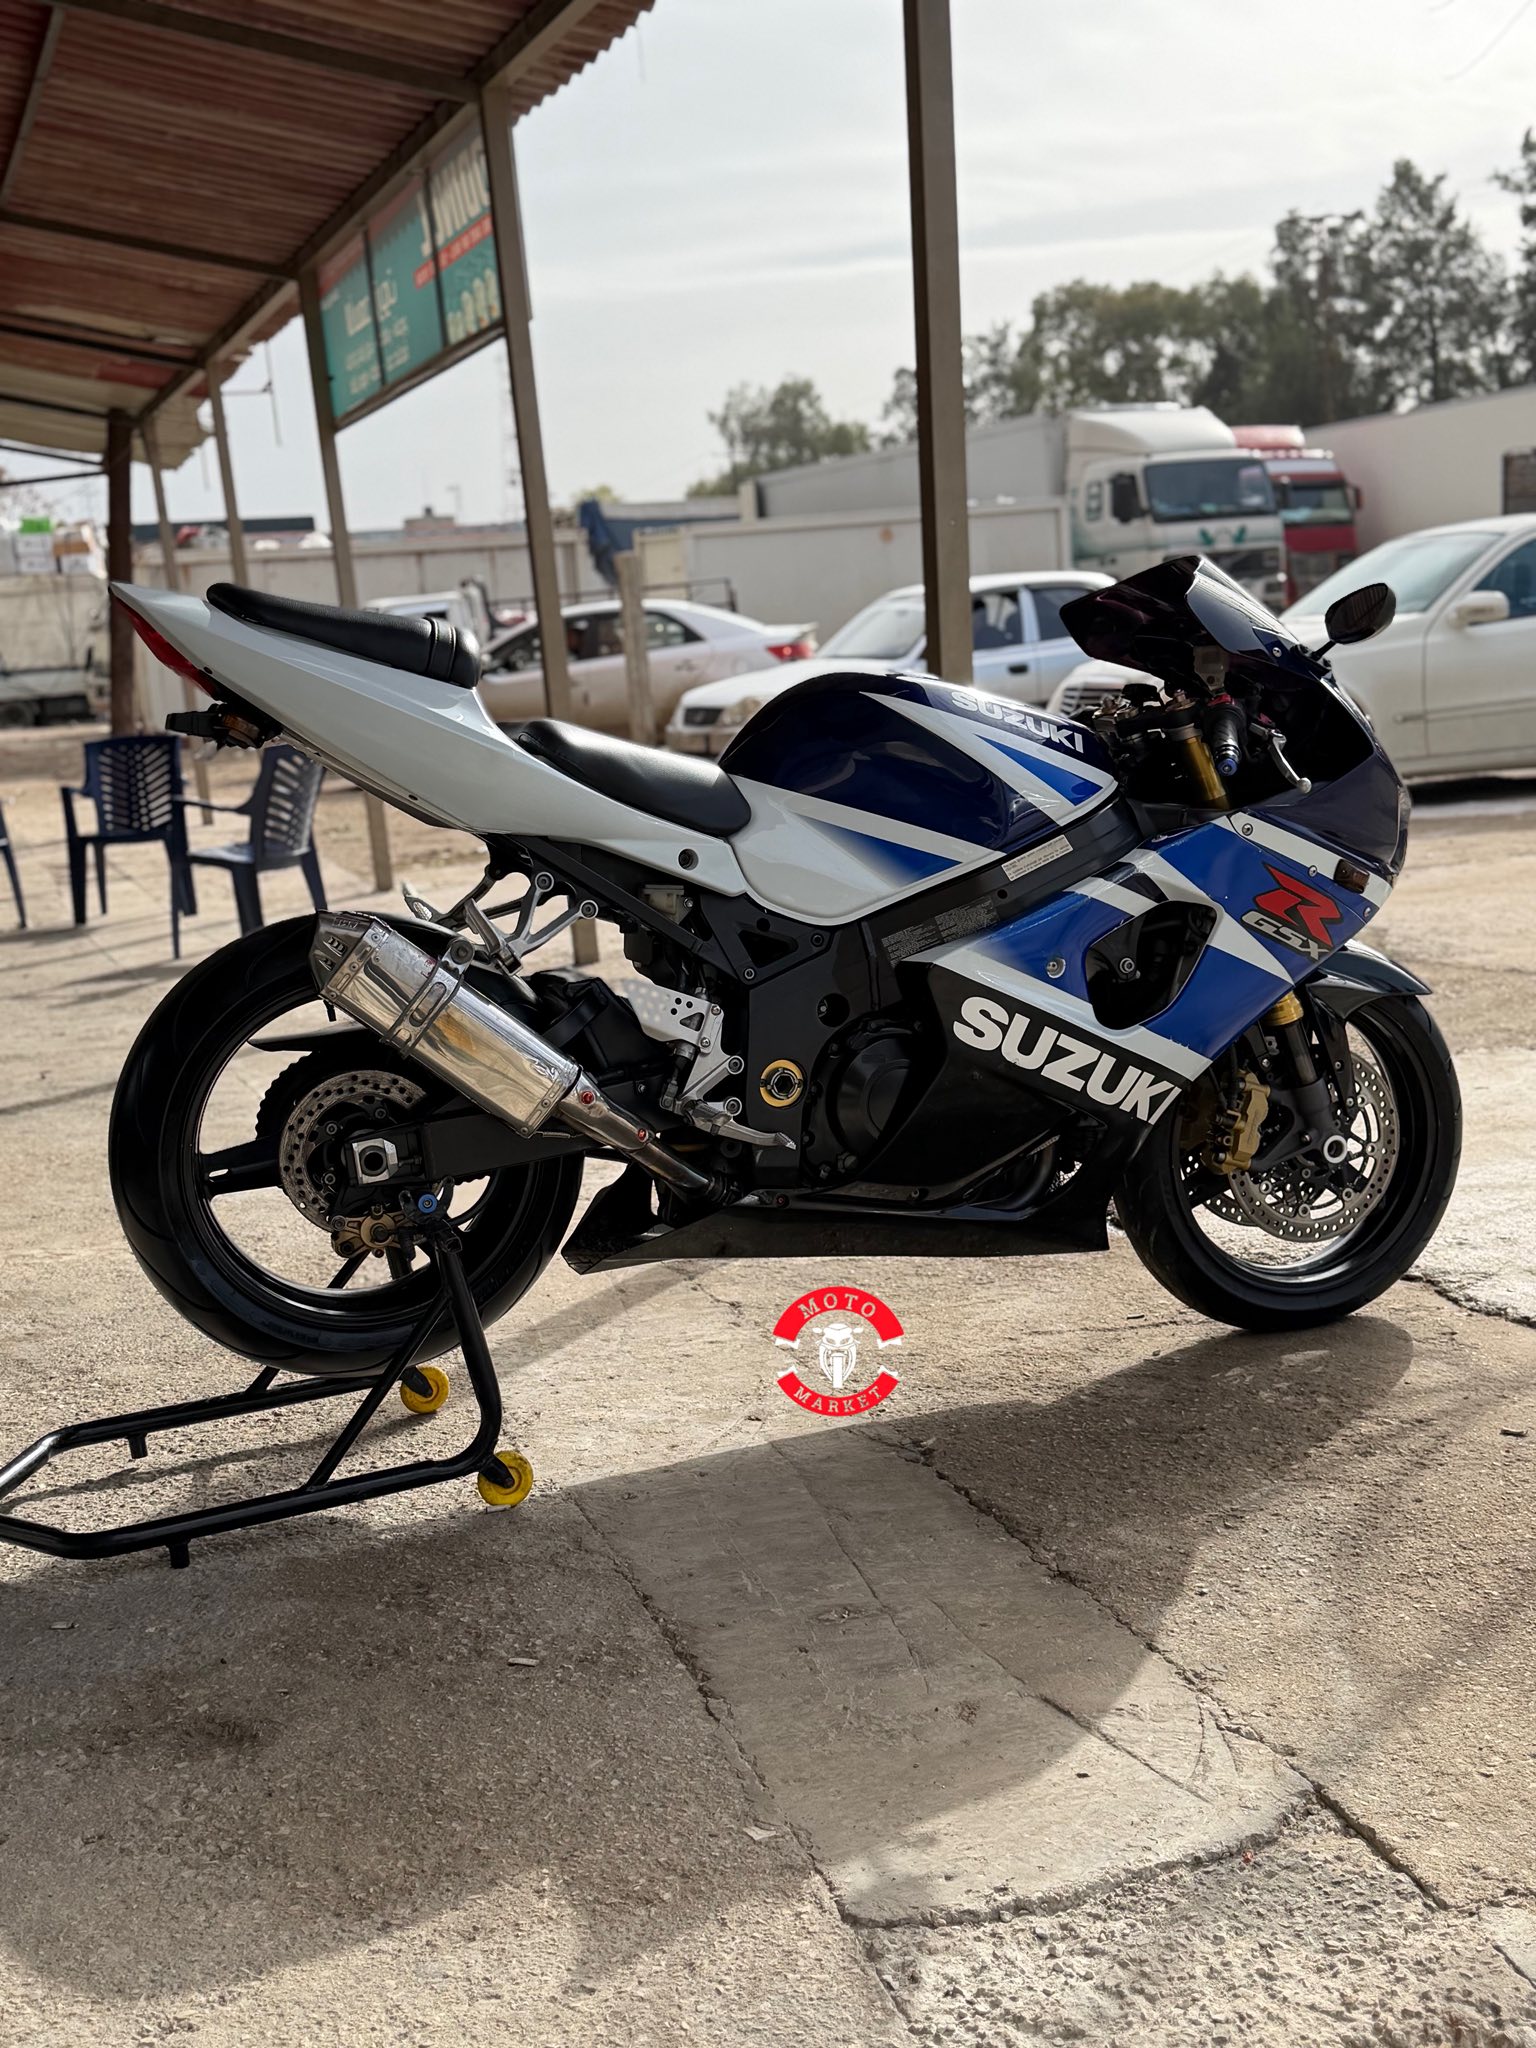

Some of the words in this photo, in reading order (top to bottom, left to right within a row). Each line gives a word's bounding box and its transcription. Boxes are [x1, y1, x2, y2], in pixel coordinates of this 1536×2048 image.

[952, 691, 1084, 754] SUZUKI
[1241, 910, 1330, 961] GSX
[953, 996, 1182, 1126] SUZUKI
